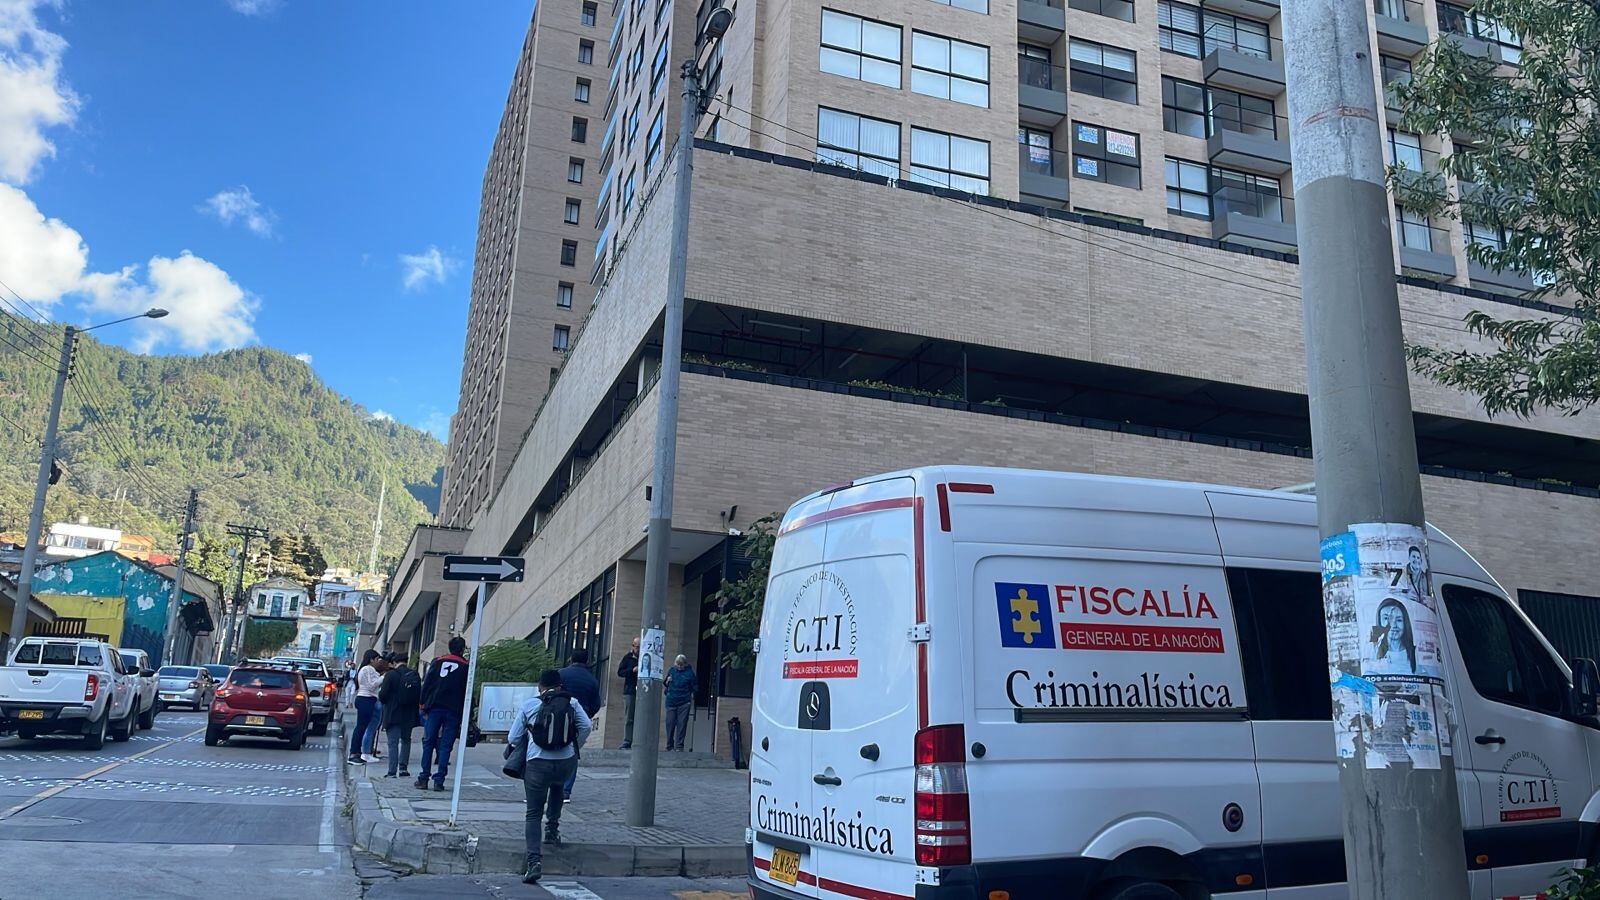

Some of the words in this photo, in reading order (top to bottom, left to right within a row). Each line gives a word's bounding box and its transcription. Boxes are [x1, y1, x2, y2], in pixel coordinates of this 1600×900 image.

[1054, 584, 1219, 619] FISCALÍA
[793, 615, 843, 654] C.T.I
[1066, 630, 1131, 646] GENERAL
[1132, 632, 1151, 647] DE
[1155, 634, 1173, 648] LA
[1174, 631, 1220, 649] NACIÓN
[1006, 669, 1233, 708] Criminalística
[1507, 779, 1549, 805] C.T.I
[757, 794, 894, 856] Criminalística
